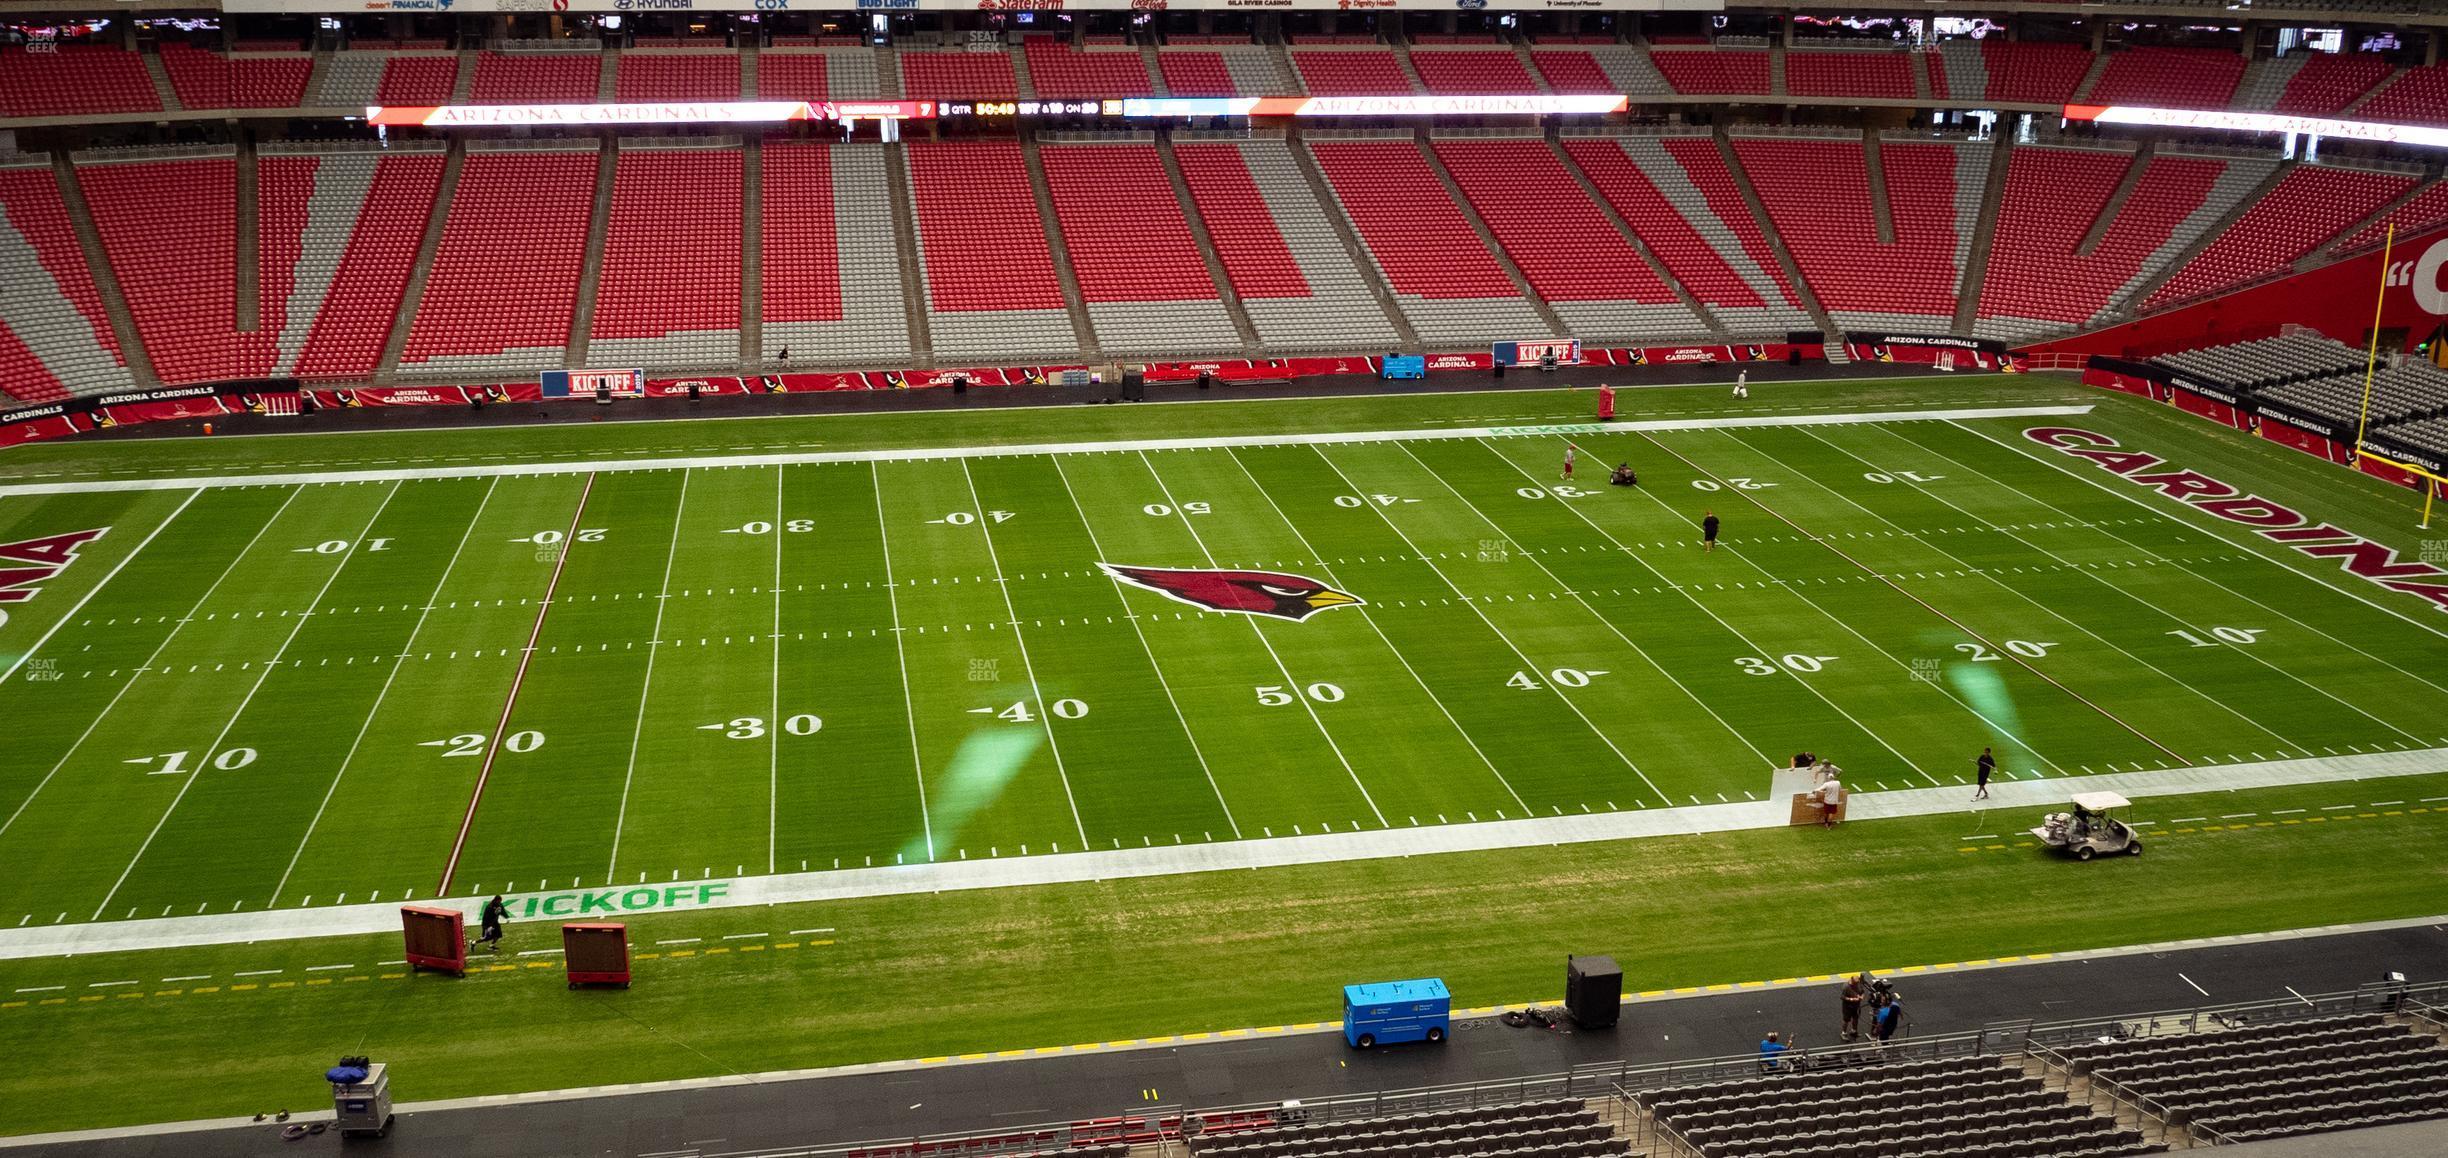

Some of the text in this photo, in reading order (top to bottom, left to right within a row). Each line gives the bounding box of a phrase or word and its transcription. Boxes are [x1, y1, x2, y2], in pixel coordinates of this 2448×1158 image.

[638, 0, 693, 8] HYUNDAI
[755, 0, 788, 9] COX
[1353, 0, 1375, 8] Dignity
[1462, 0, 1483, 8] Ford
[444, 105, 733, 121] ARIZONA CARDINALS
[920, 103, 931, 116] 7
[951, 104, 972, 115] QTR
[1066, 104, 1080, 113] ON
[1313, 99, 1564, 112] ARIZONA CARDINALS
[2267, 116, 2398, 142] CARDINALS
[1884, 335, 1979, 348] ARIZONA CARDINALS
[1428, 360, 1477, 368] CARDINALS
[100, 386, 215, 406] ARIZONA CARDINALS
[383, 394, 441, 403] CARDINALS
[2171, 377, 2237, 405] ARIZONA CARDINALS
[2, 405, 63, 423] CARDINALS
[2256, 406, 2332, 436] ARIZONA CARDINALS
[1488, 423, 1611, 436] KICKOFF
[2391, 450, 2441, 471] CARDINALS
[1143, 502, 1212, 516] 50
[2165, 627, 2257, 647] 10
[1954, 640, 2047, 661] 20
[1734, 654, 1823, 675] 30
[1506, 668, 1590, 690] 40
[1255, 683, 1345, 706] 50
[997, 699, 1089, 722] 40
[726, 714, 822, 739] 30
[441, 731, 545, 757] 20
[147, 748, 258, 775] 10
